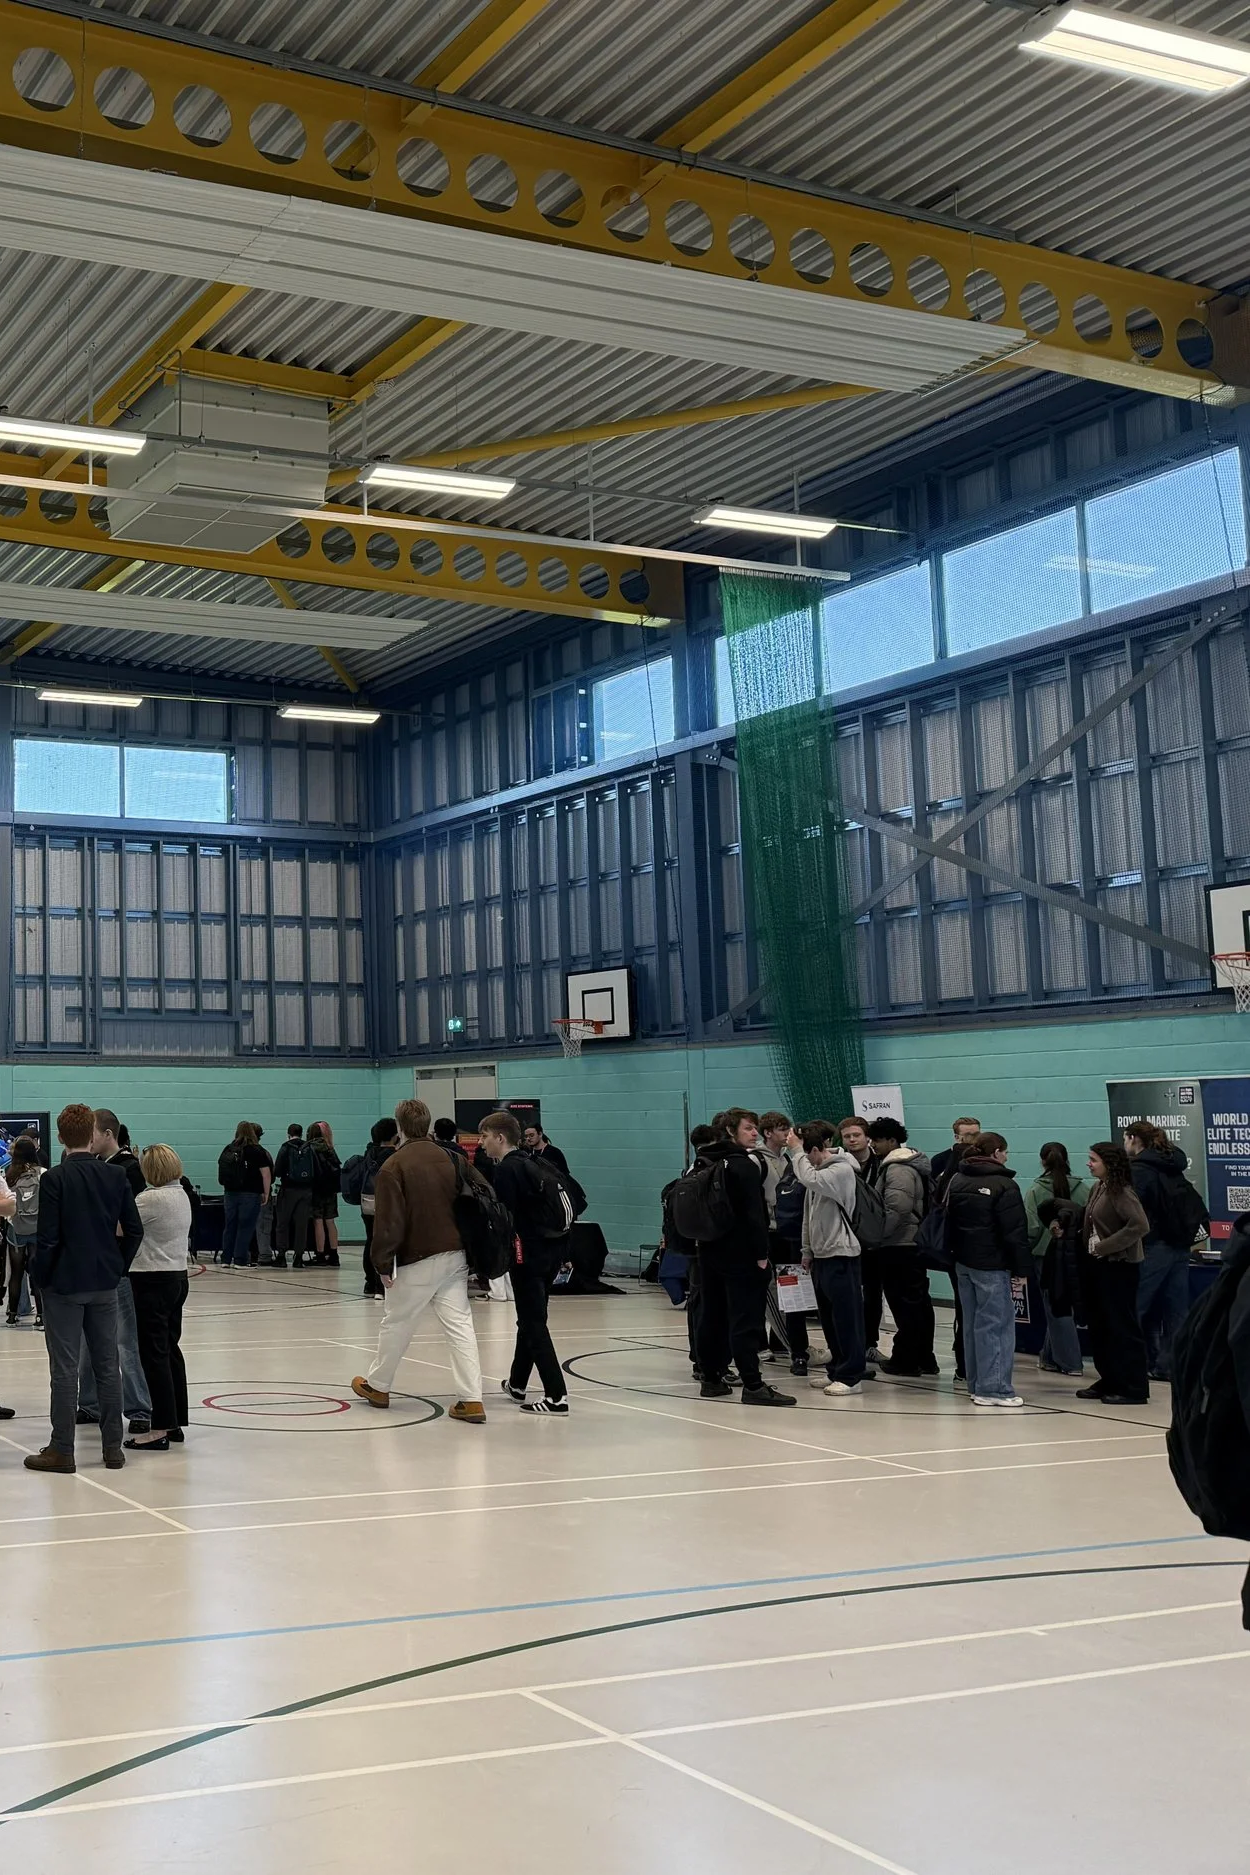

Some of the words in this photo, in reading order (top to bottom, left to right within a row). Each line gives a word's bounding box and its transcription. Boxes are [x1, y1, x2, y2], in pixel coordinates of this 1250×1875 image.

[1146, 1114, 1190, 1127] MARINES.
[1212, 1113, 1249, 1126] WORLD
[1207, 1127, 1231, 1140] ELITE
[1208, 1142, 1250, 1155] ENDLESS
